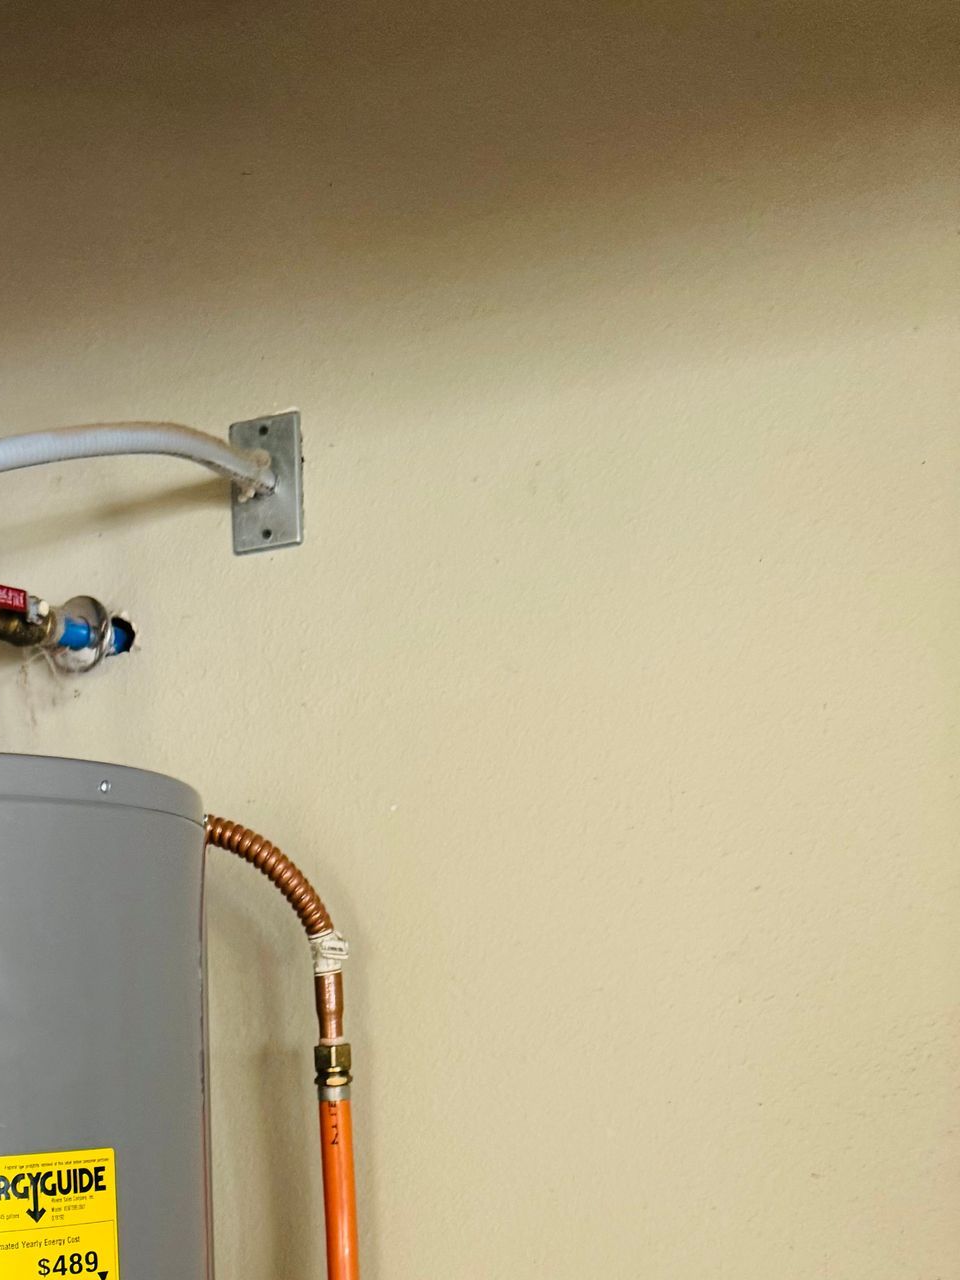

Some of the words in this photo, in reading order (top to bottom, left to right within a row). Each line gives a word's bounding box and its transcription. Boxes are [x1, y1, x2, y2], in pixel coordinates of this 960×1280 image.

[21, 1239, 42, 1249] Yearly
[44, 1237, 66, 1246] Energy
[67, 1236, 80, 1244] Cost
[38, 1251, 98, 1278] $489
